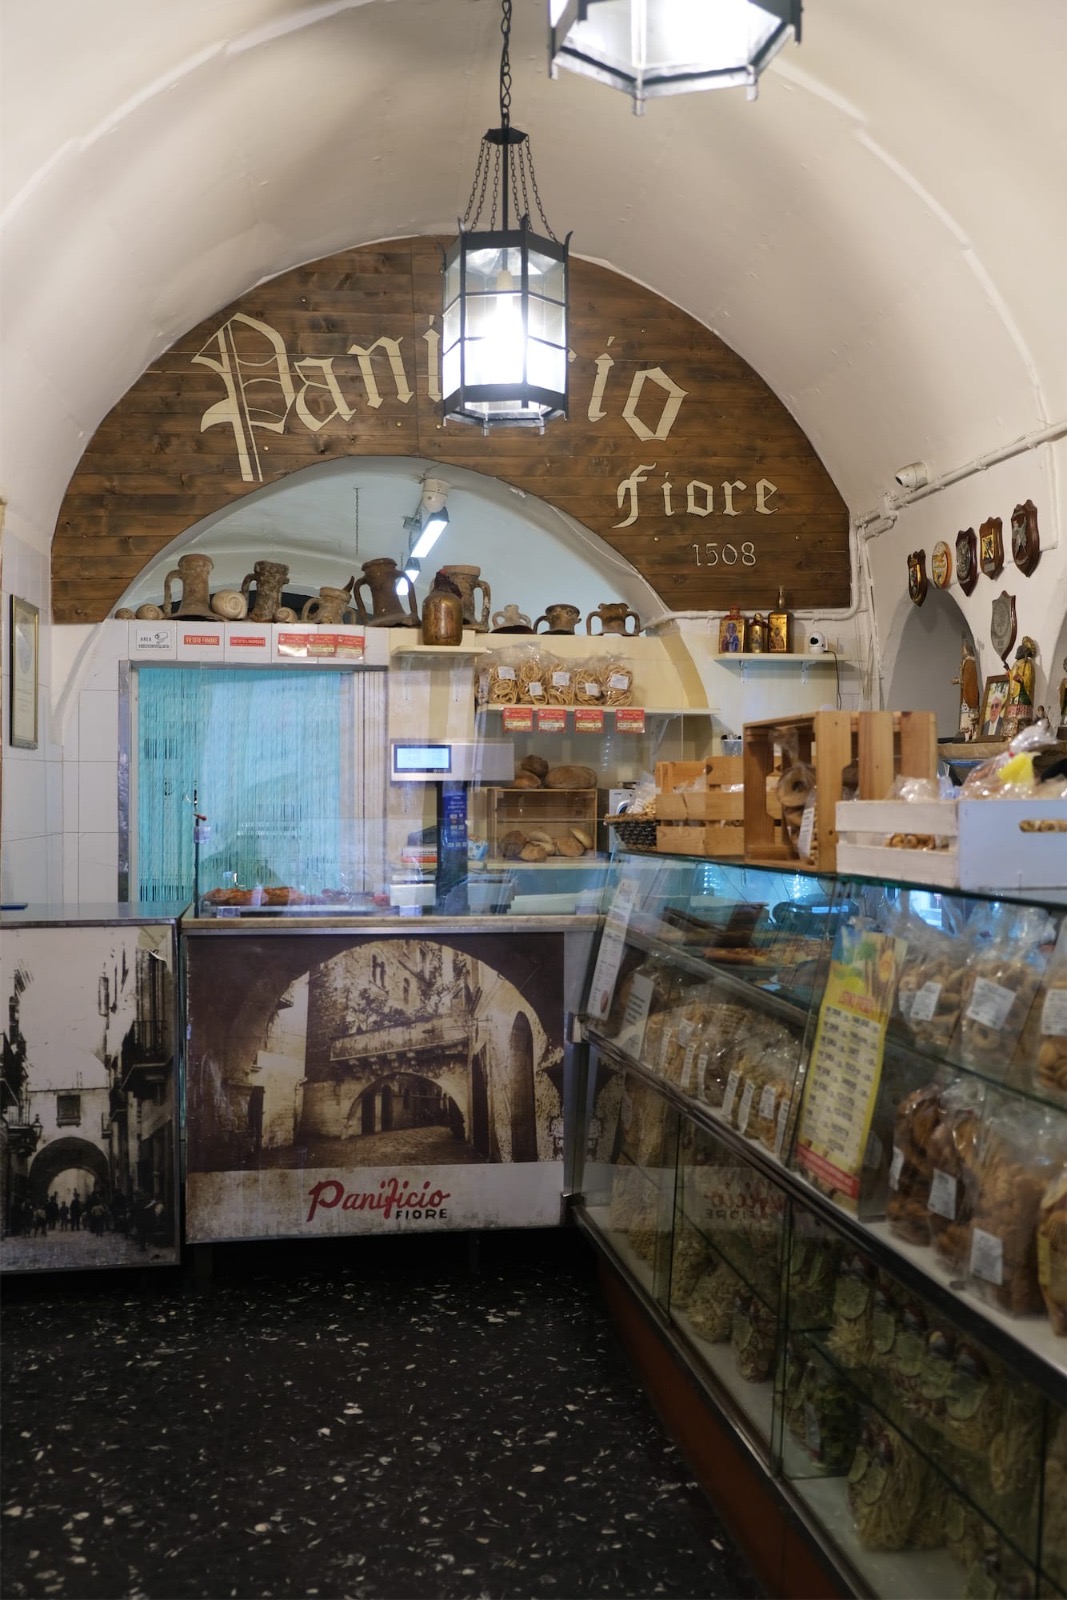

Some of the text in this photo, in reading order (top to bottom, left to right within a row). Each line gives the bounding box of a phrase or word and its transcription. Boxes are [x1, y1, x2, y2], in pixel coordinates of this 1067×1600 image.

[190, 311, 690, 483] Paniio
[691, 541, 757, 567] 1508
[306, 1177, 451, 1223] Panificio
[395, 1208, 448, 1220] FIORE
